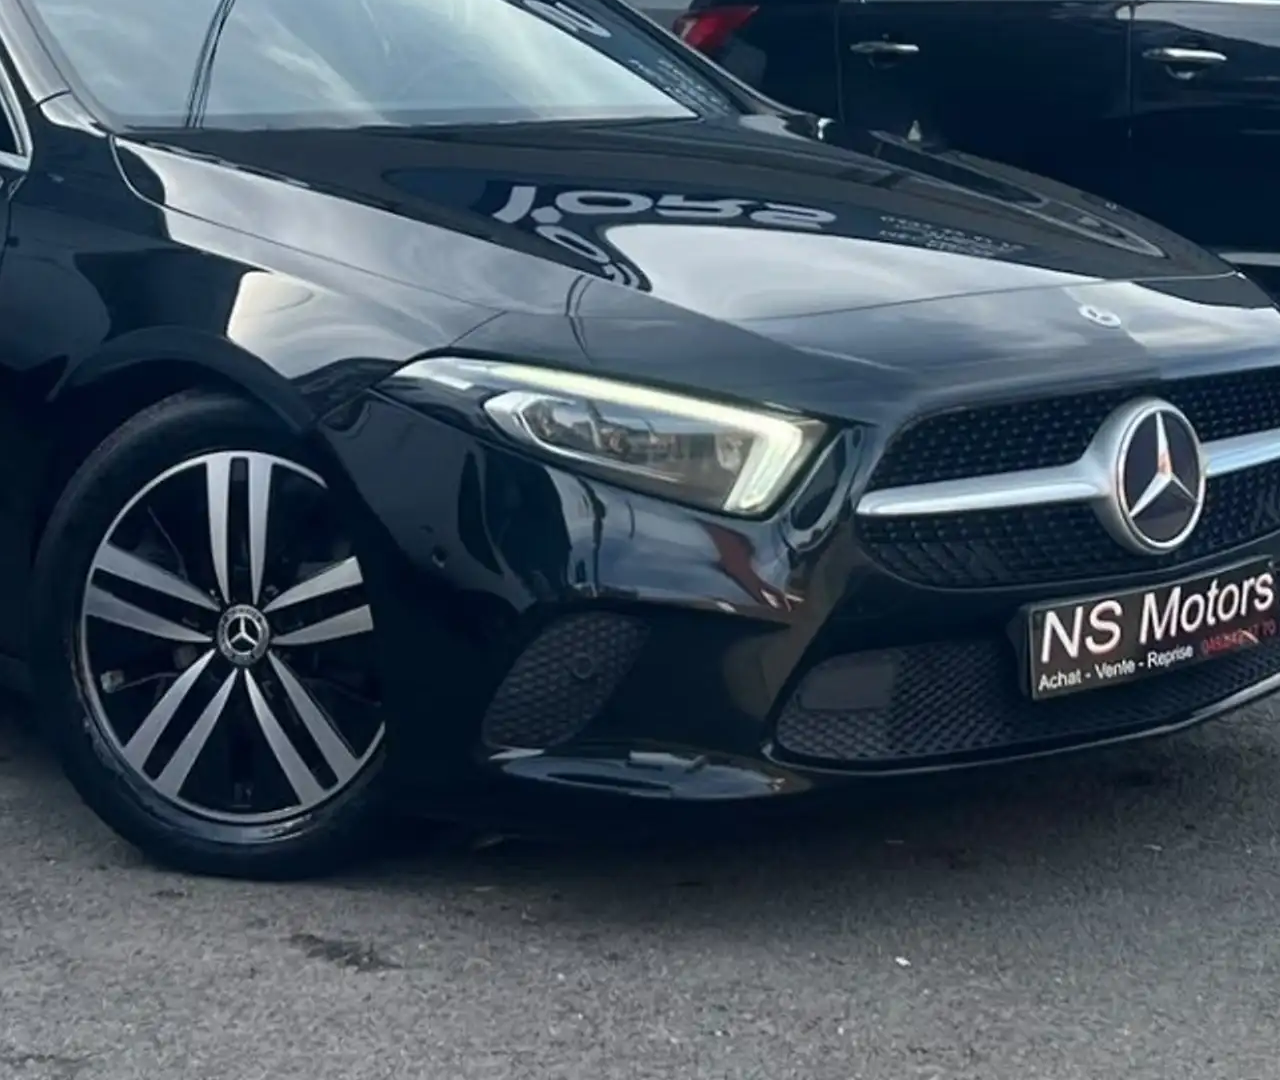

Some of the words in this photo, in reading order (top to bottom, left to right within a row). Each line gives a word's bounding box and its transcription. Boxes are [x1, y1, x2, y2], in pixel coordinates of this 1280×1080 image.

[1040, 599, 1123, 664] NS
[1138, 571, 1275, 646] Motors
[1037, 662, 1083, 692] Achat
[1094, 657, 1136, 680] Vente
[1147, 644, 1194, 670] Reprise
